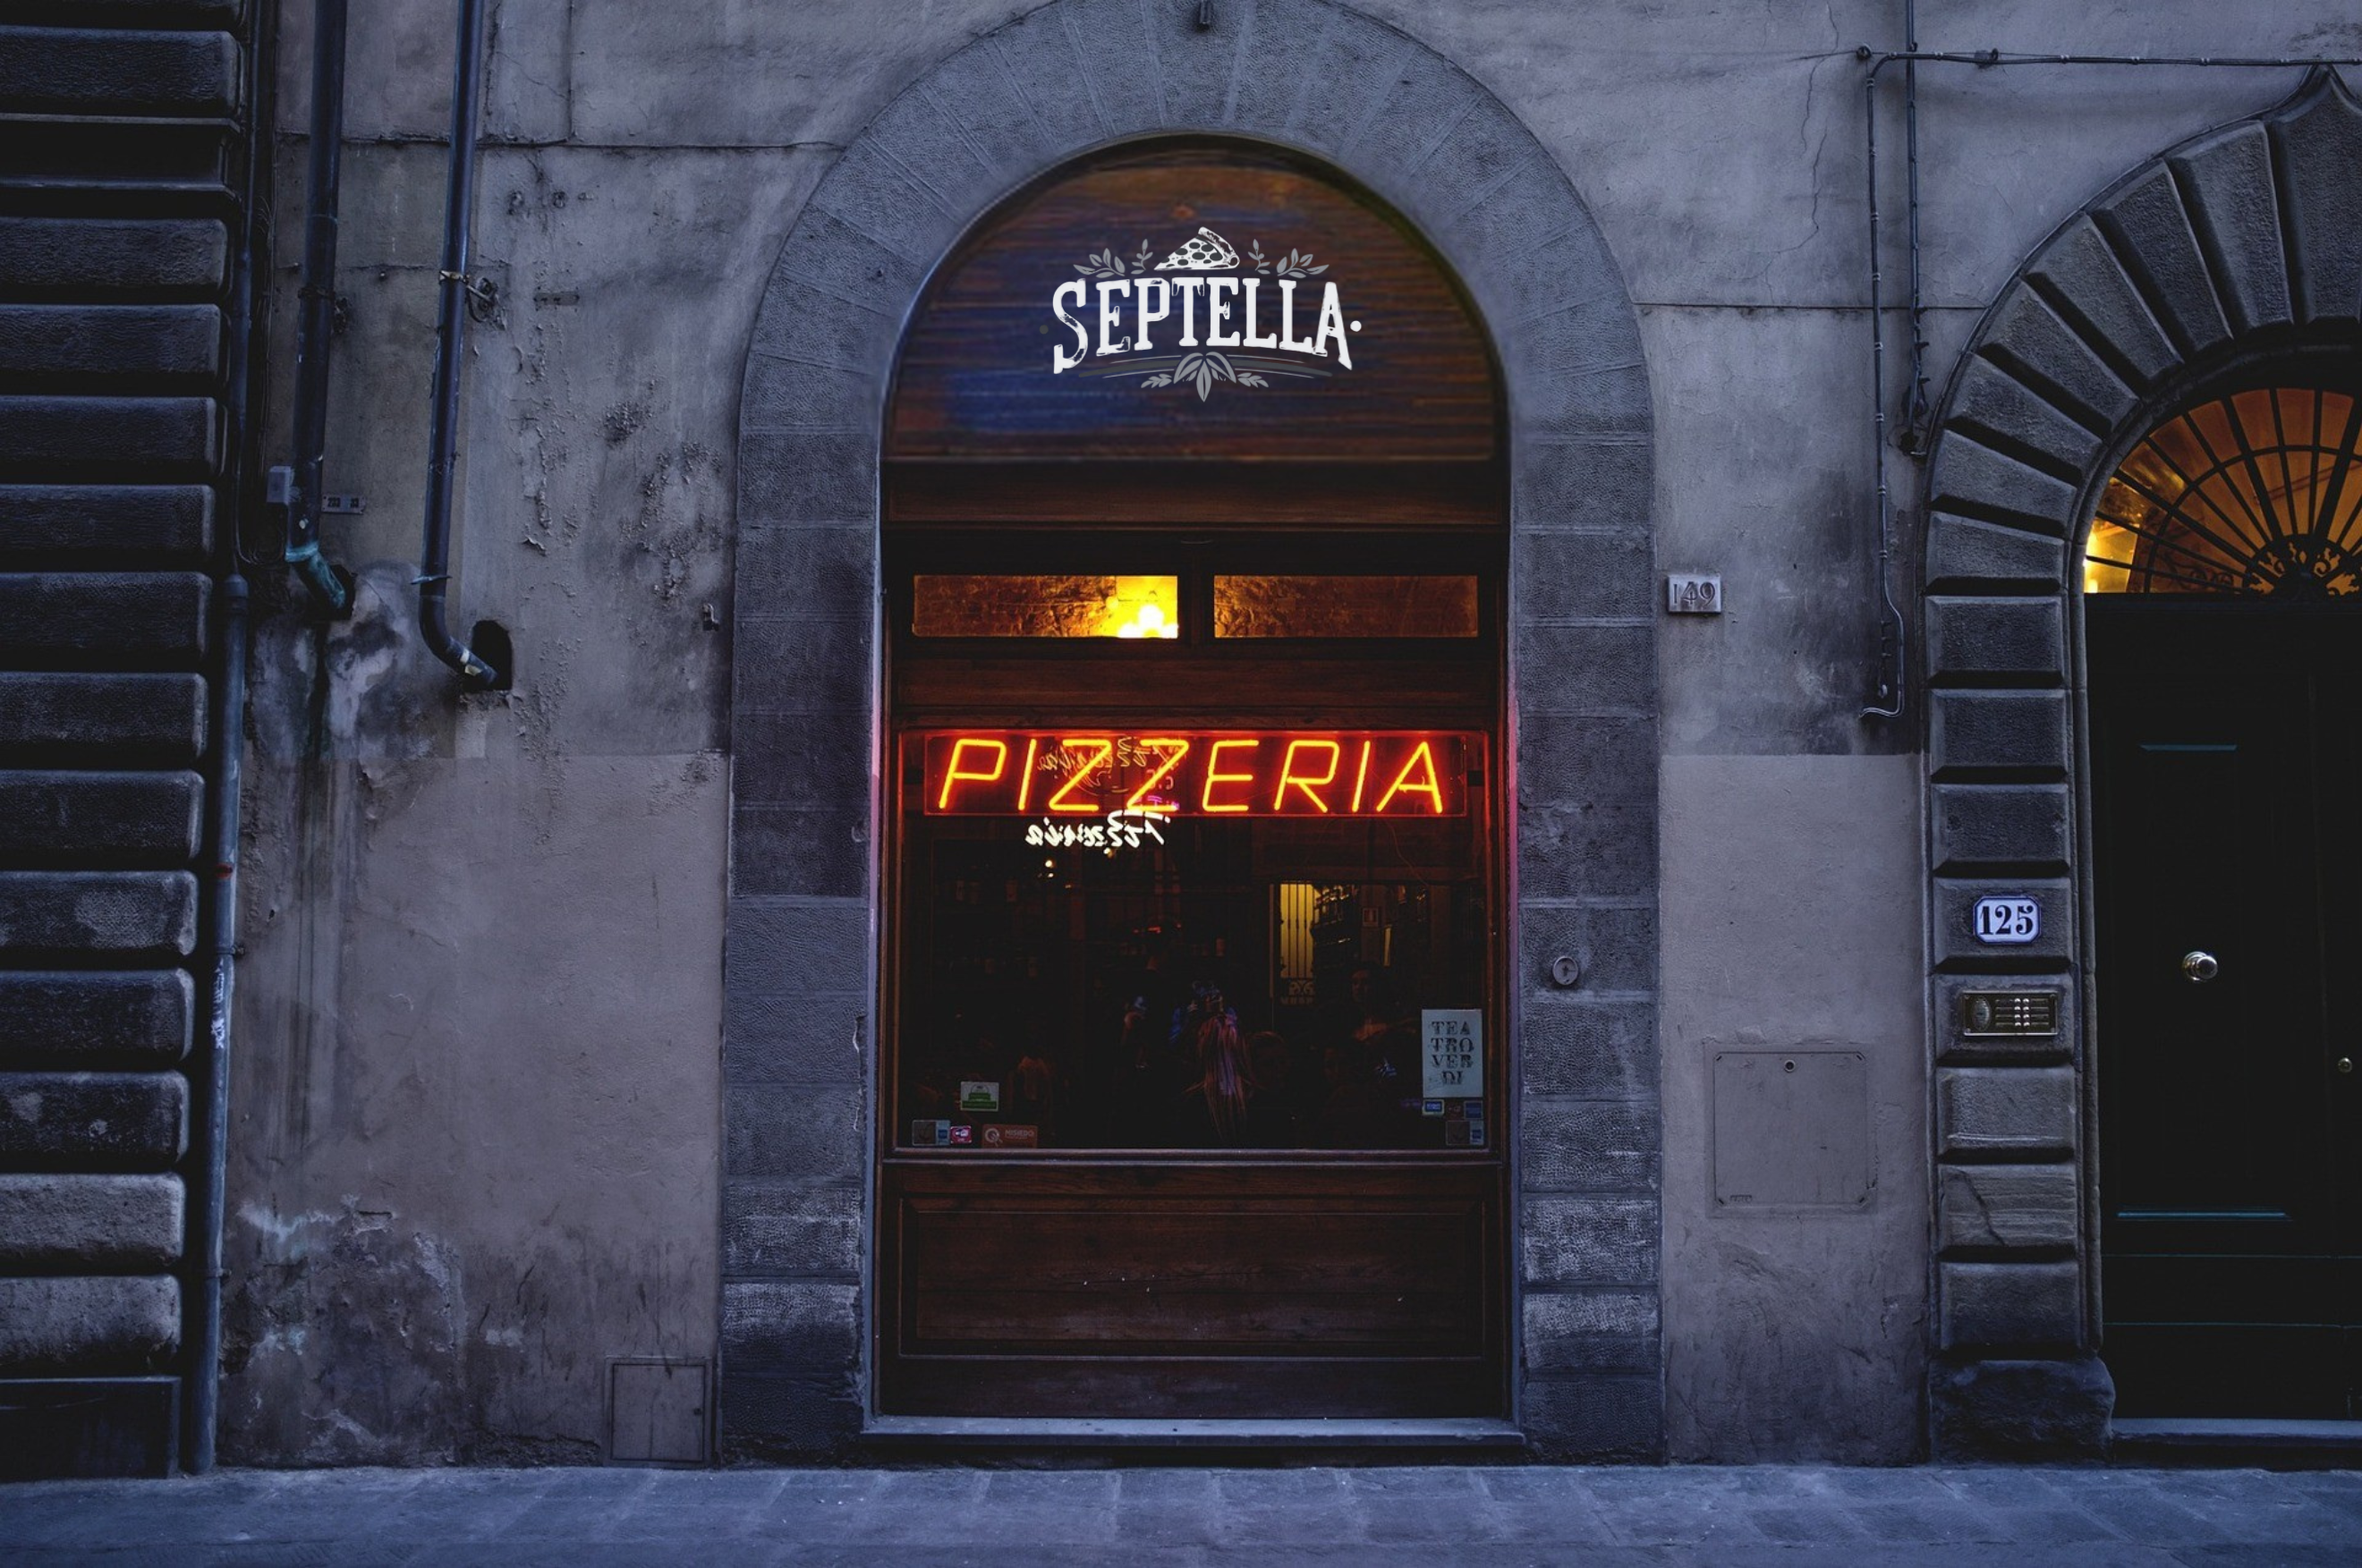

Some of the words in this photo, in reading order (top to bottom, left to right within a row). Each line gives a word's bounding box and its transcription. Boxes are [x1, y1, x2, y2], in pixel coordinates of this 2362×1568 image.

[1052, 276, 1353, 374] SEPTELLA
[1673, 581, 1715, 606] 149
[938, 739, 1443, 814] PIZZERIA
[1979, 904, 2034, 935] 125
[1431, 1021, 1471, 1035] TEA
[1430, 1038, 1474, 1053] TRO
